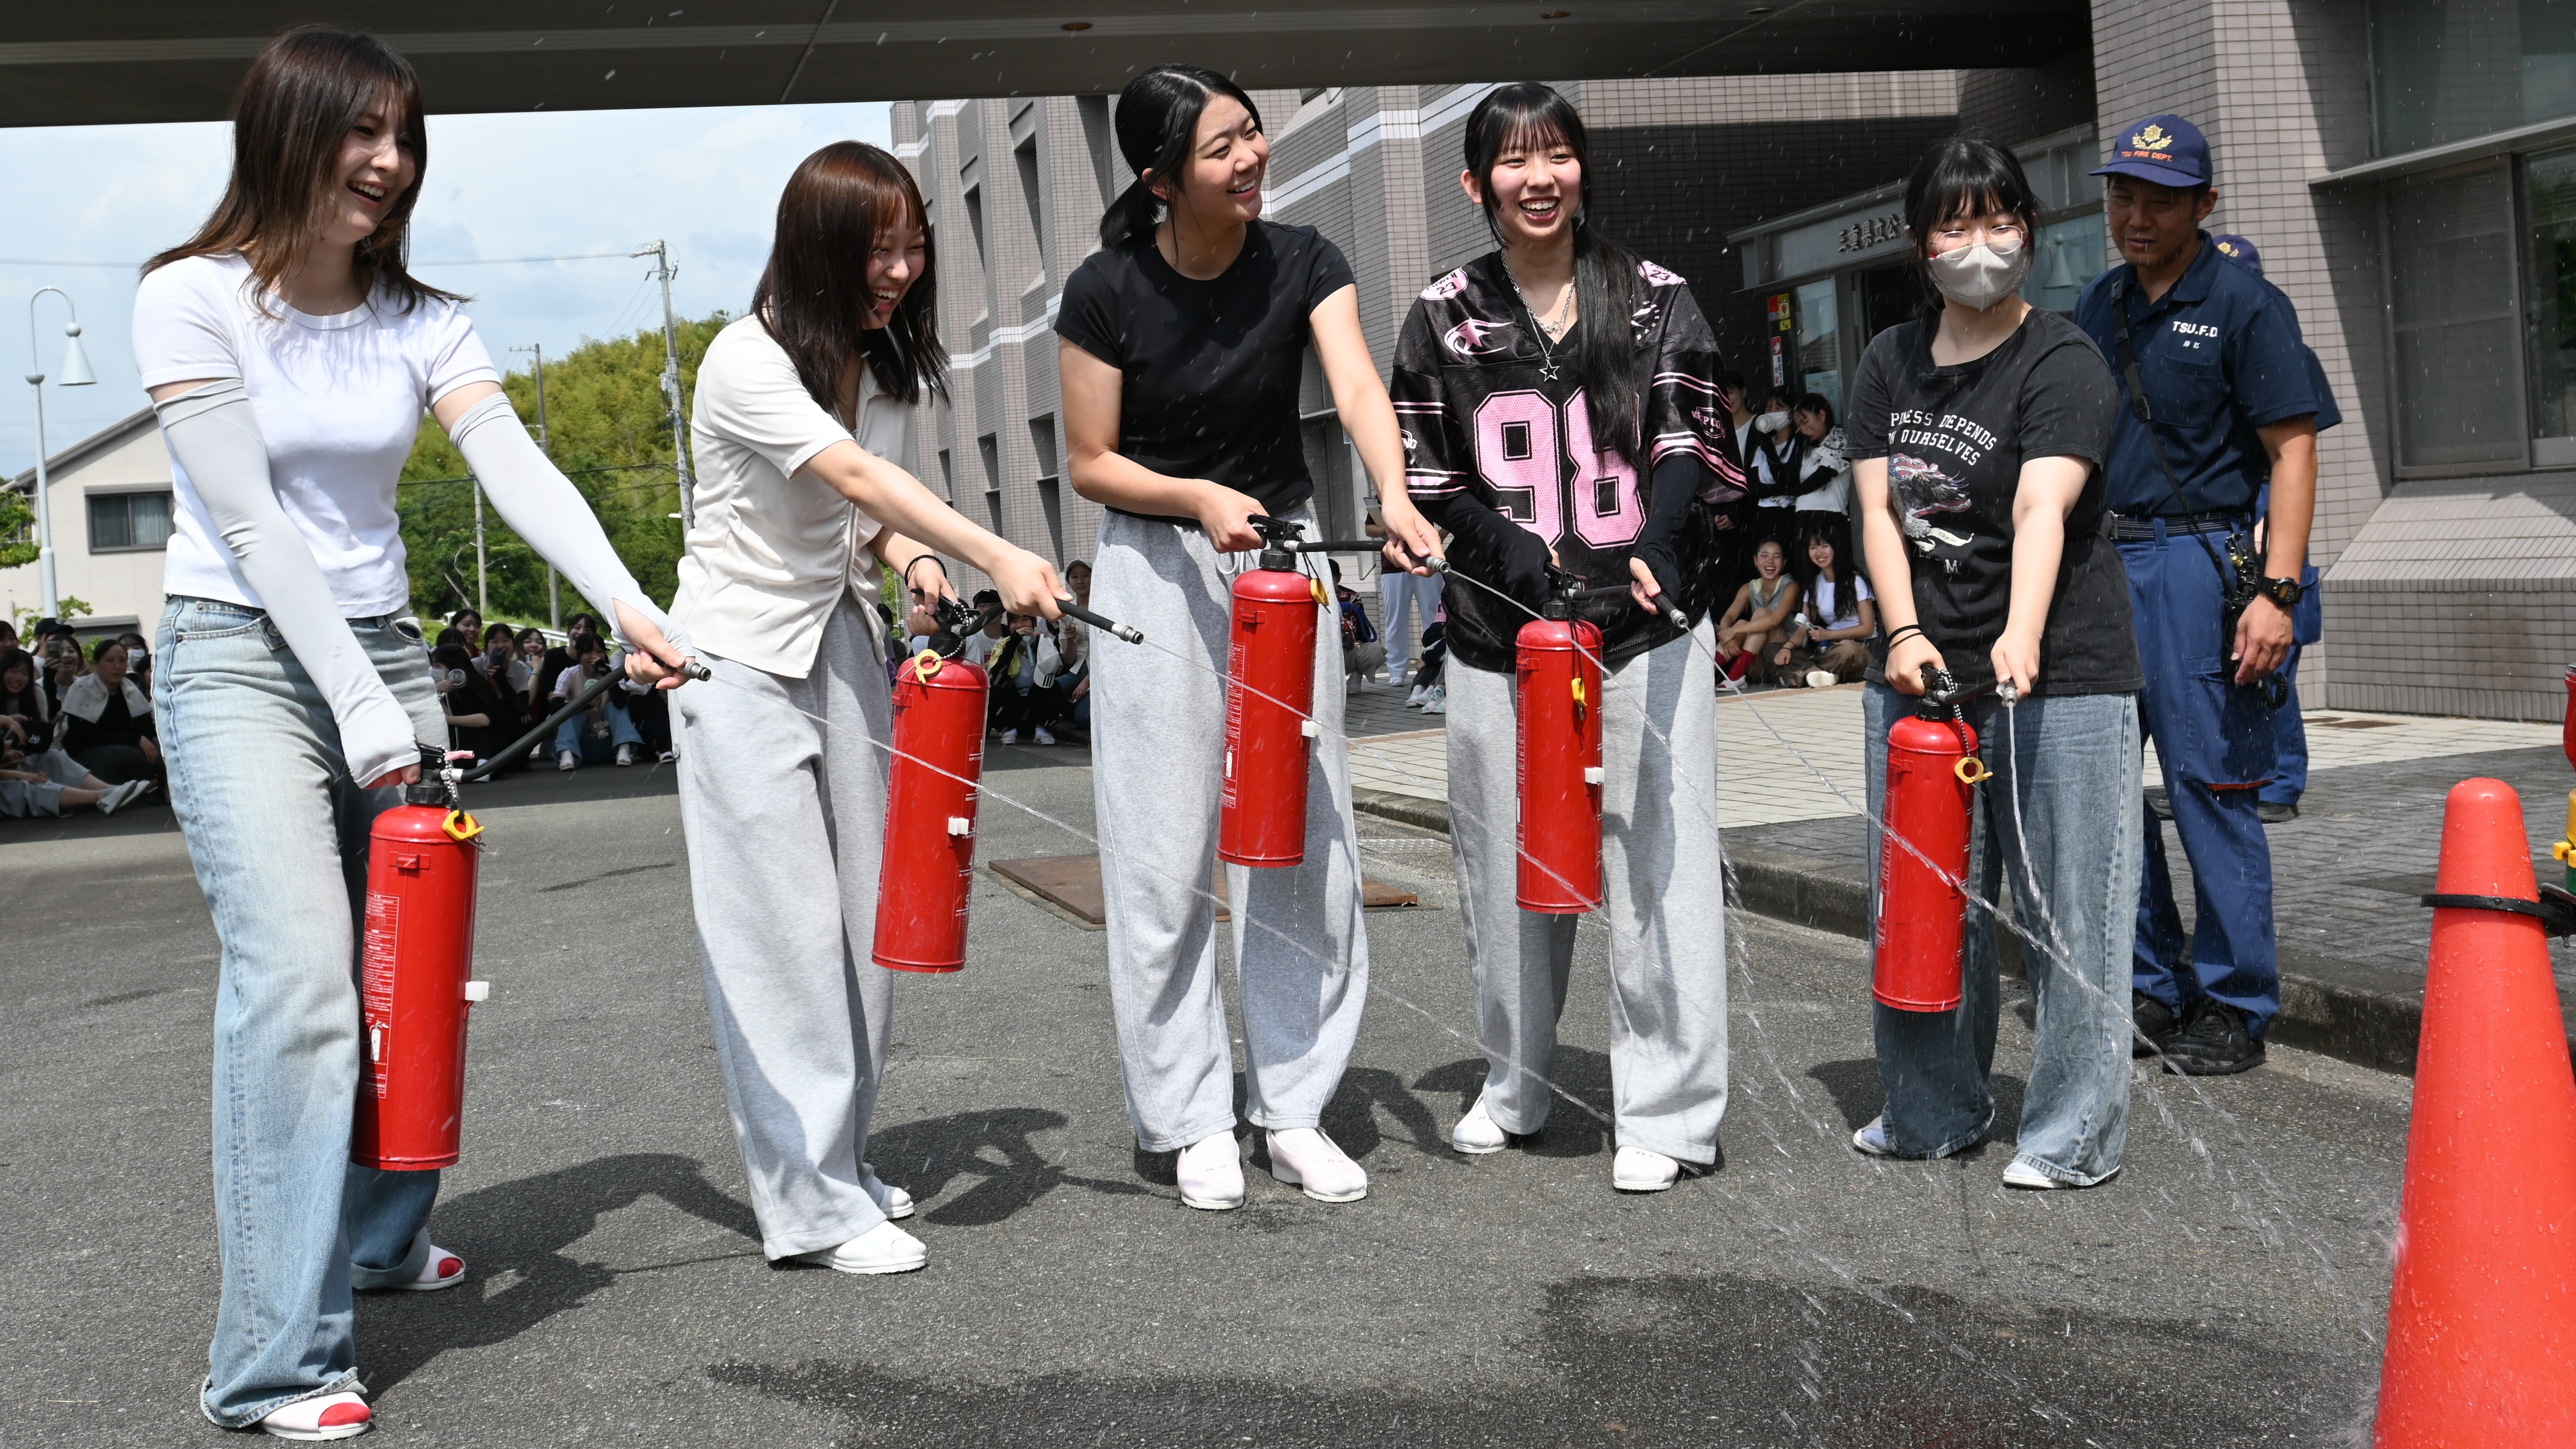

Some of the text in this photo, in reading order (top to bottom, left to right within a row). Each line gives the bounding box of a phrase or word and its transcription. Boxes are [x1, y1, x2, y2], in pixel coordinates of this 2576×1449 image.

[2151, 152, 2173, 162] DEPT.
[1436, 281, 1457, 295] 23
[1650, 270, 1671, 281] 23
[1939, 414, 1997, 451] DEPENDS
[1901, 429, 1981, 466] OURSELVES
[1473, 386, 1647, 550] 98
